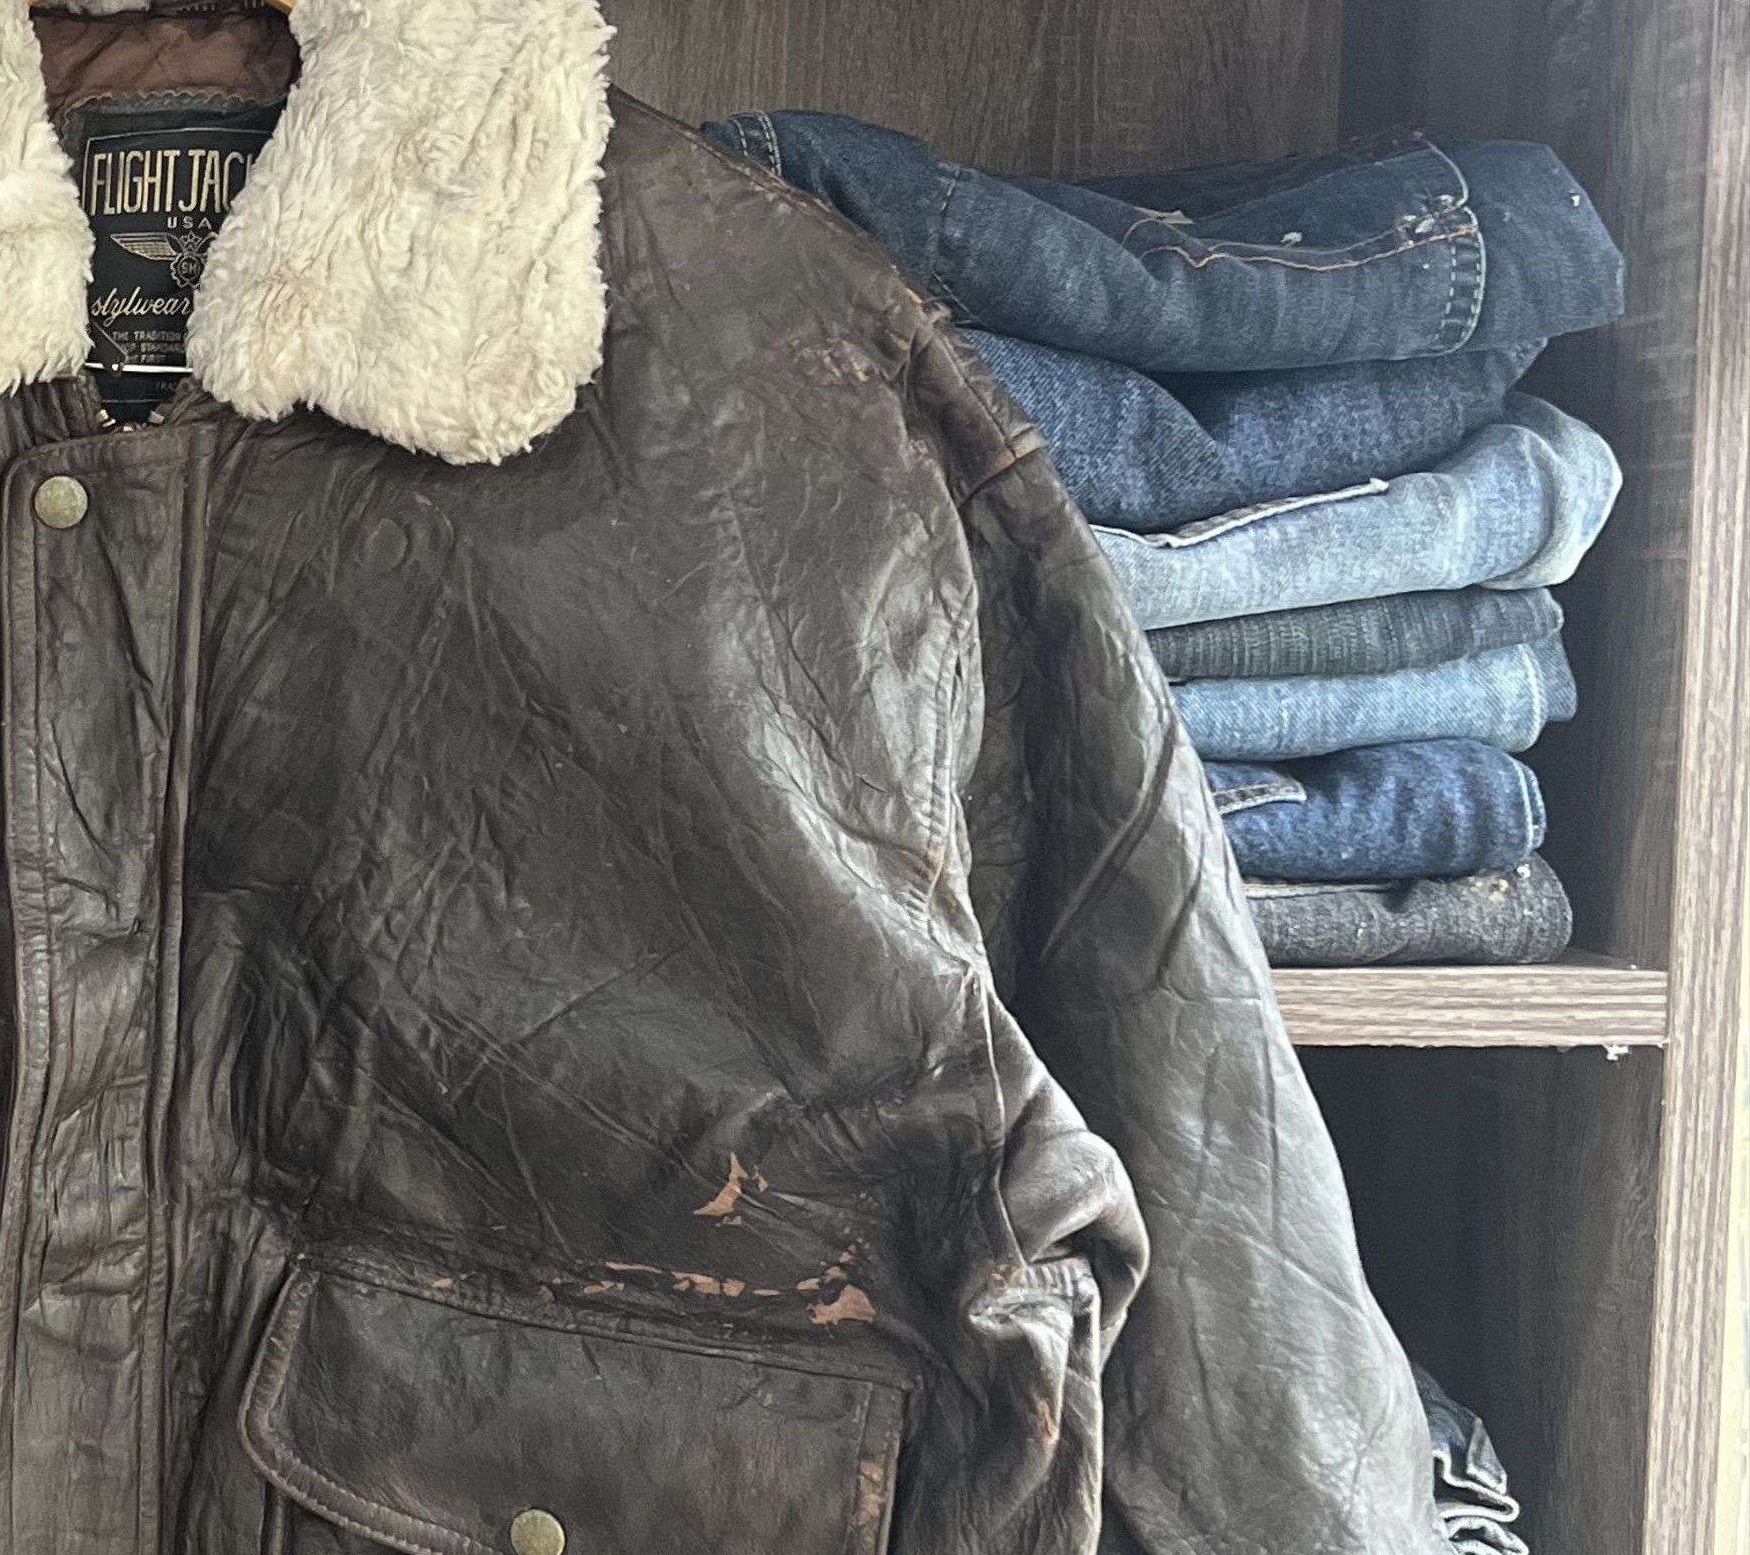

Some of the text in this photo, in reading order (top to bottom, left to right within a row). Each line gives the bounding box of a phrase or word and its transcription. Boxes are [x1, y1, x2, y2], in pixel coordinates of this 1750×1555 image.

[91, 149, 181, 216] FLIGHT
[167, 216, 213, 230] USA
[112, 331, 129, 342] THE
